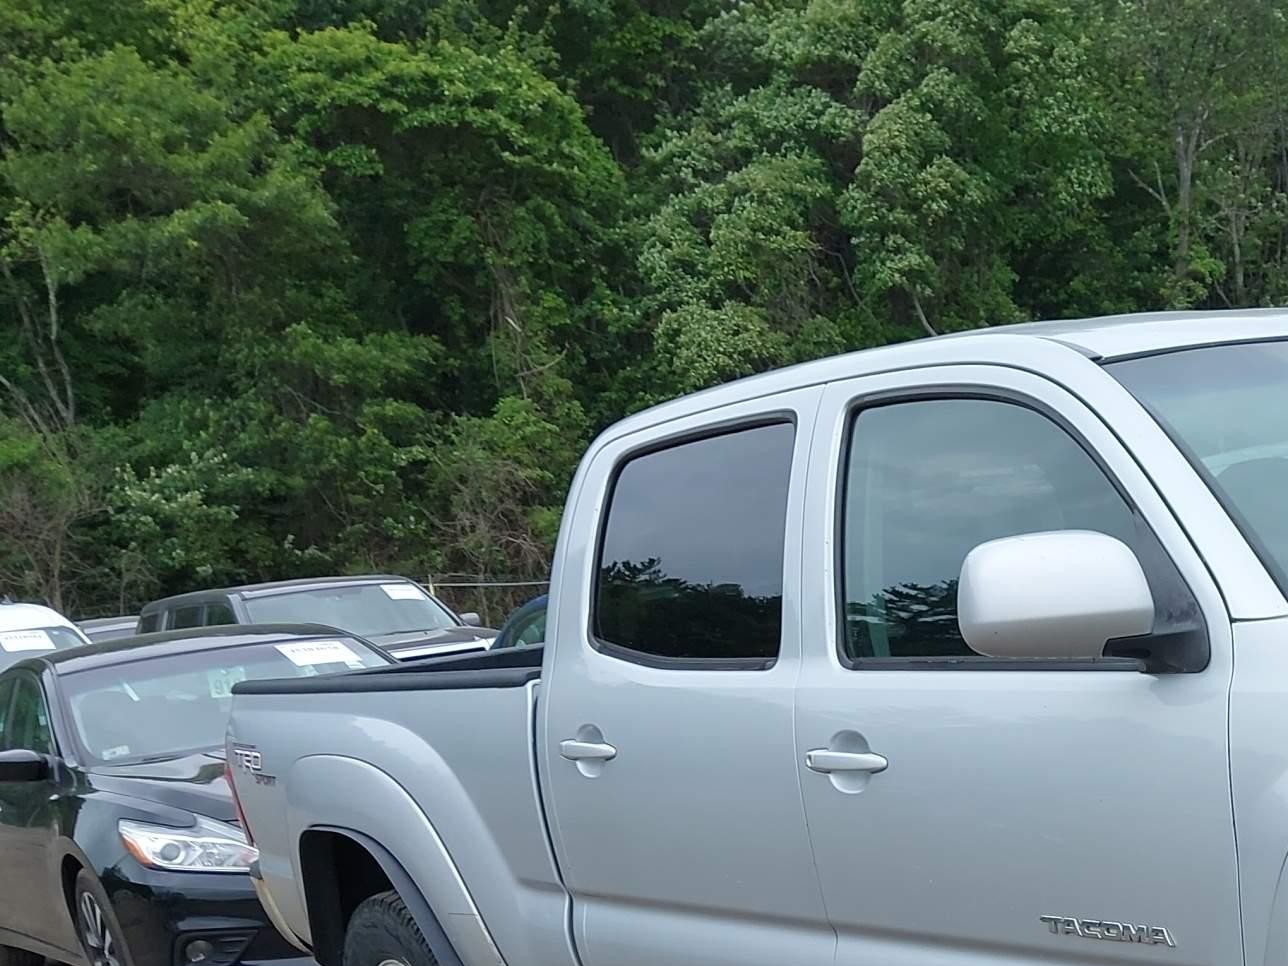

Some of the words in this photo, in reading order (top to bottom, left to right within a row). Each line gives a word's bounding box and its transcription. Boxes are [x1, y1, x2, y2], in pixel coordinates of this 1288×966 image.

[233, 749, 262, 774] TRD
[255, 774, 277, 786] SPORT
[1040, 914, 1177, 948] TACOMA
